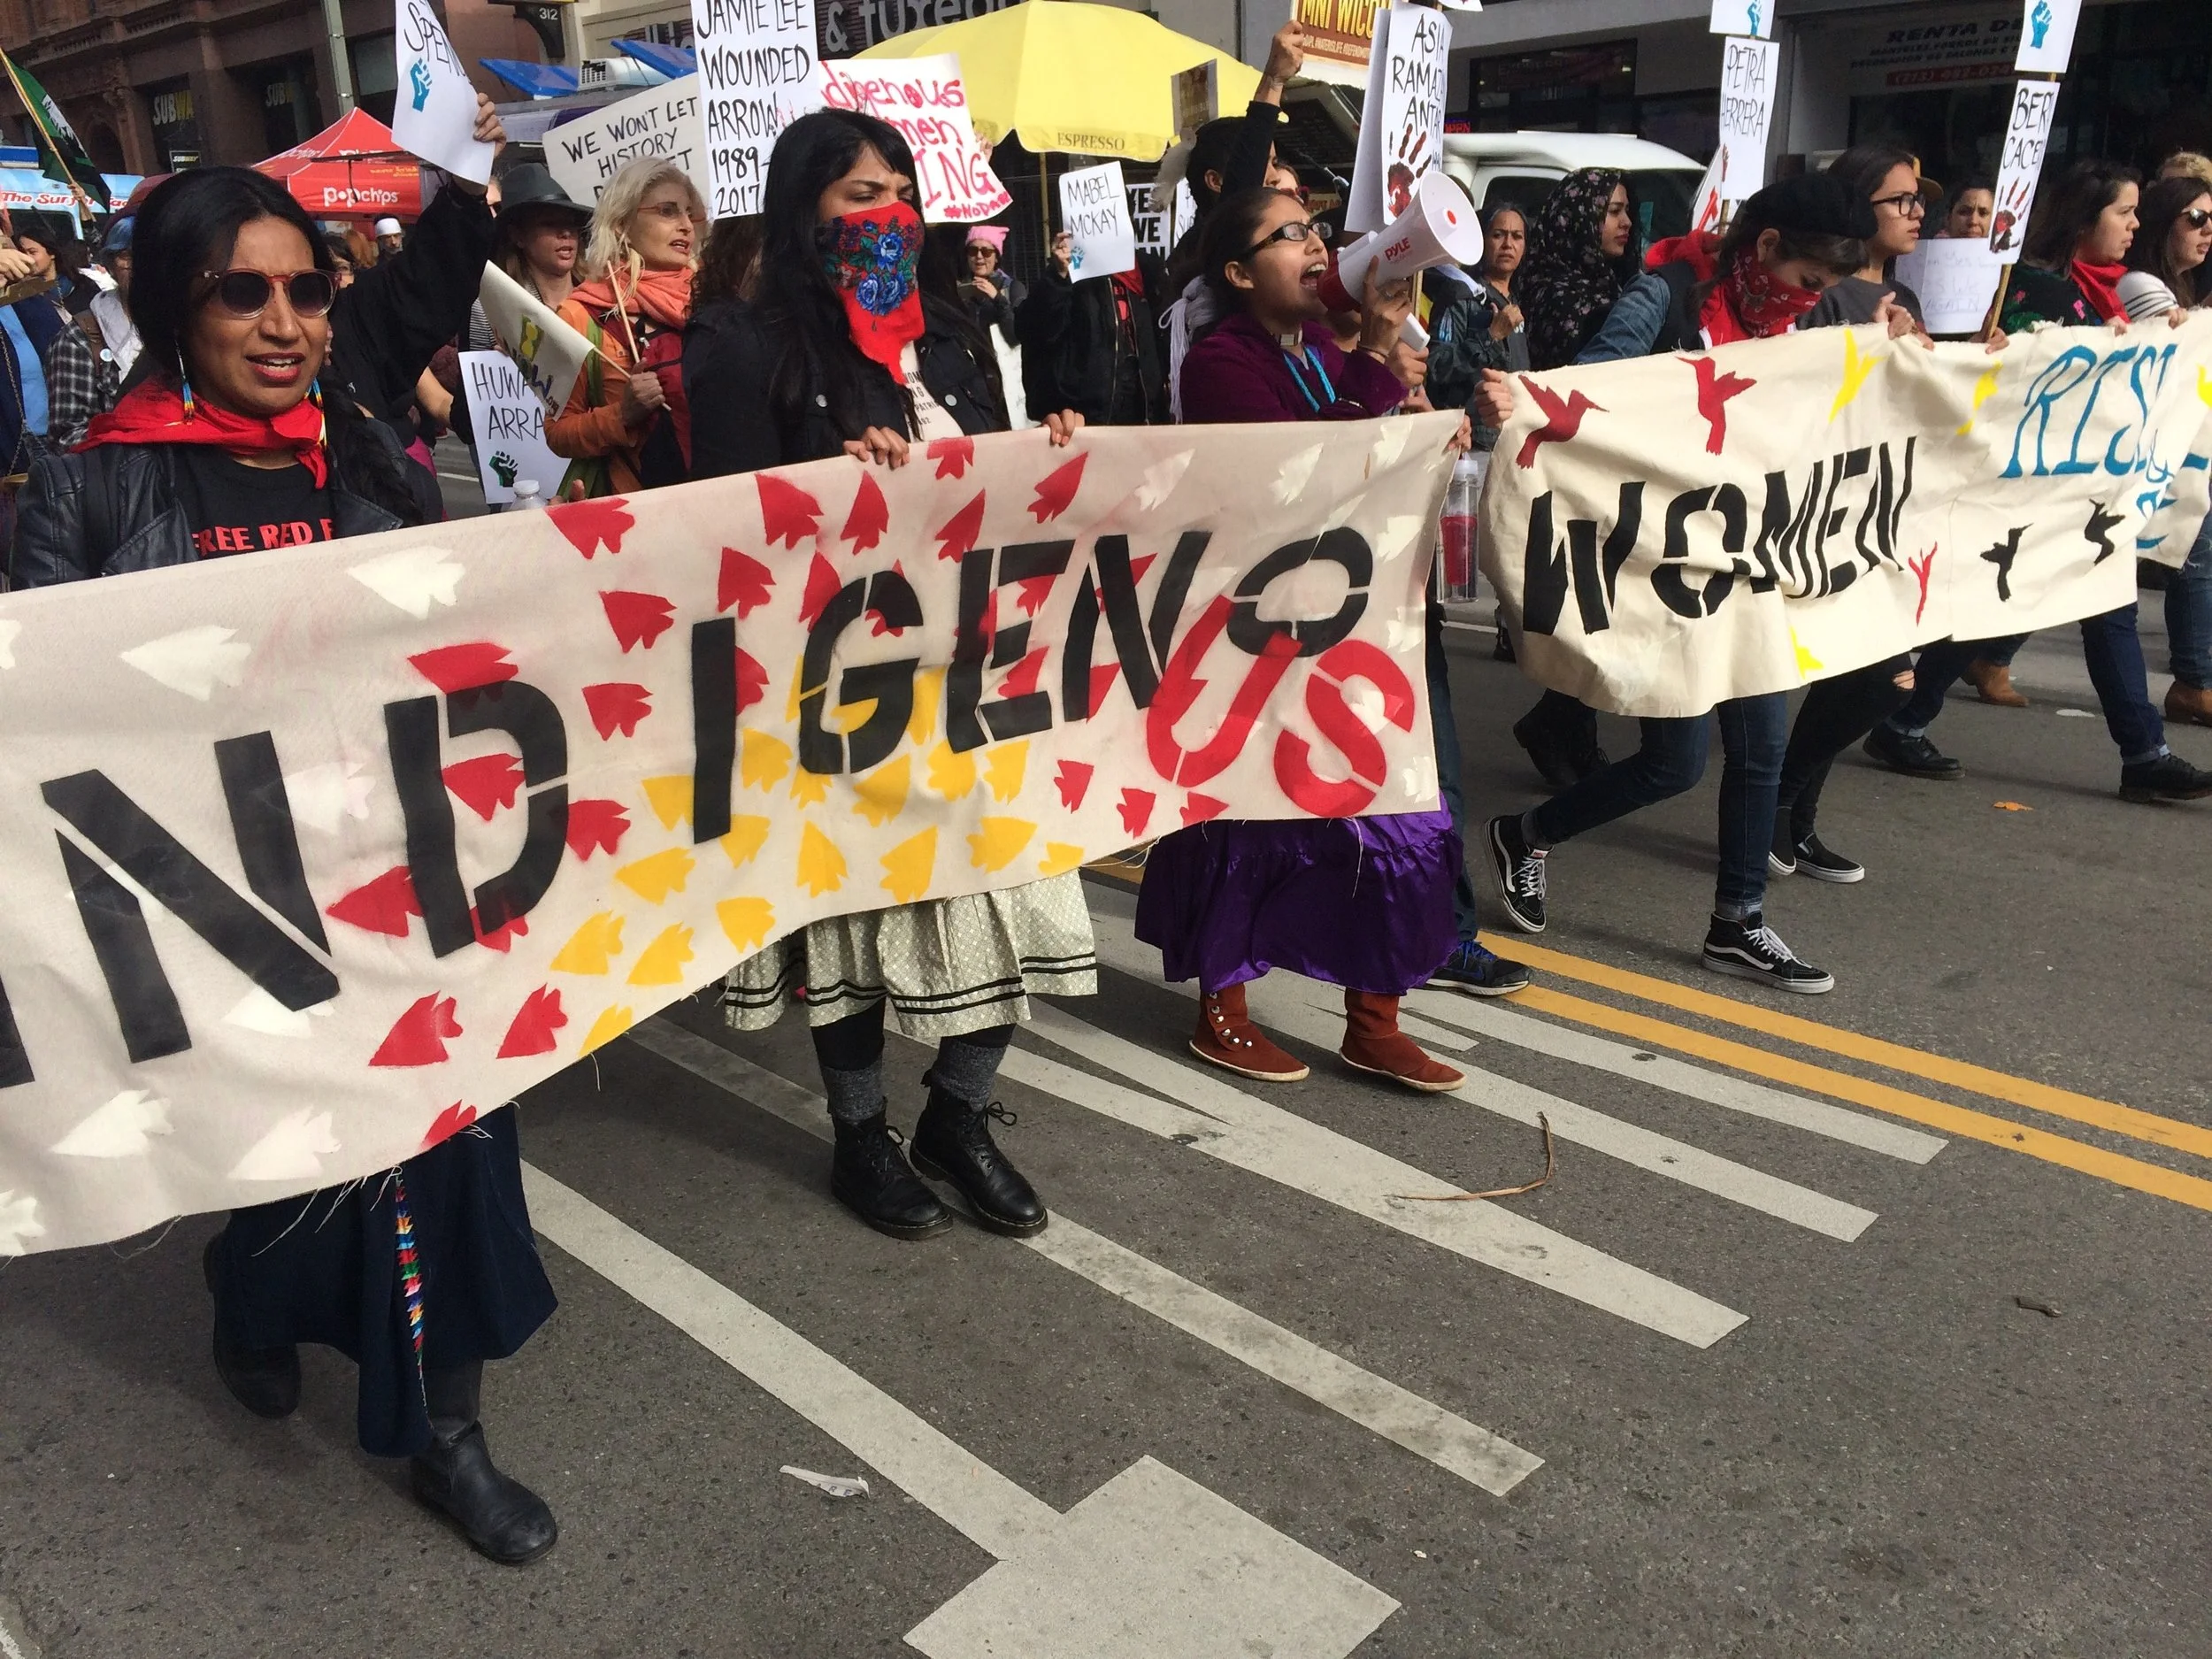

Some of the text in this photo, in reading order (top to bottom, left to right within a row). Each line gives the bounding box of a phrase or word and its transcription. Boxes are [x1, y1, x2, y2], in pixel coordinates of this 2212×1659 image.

[539, 7, 558, 21] 312
[697, 0, 769, 39] JAMIE
[775, 0, 810, 30] LEE
[857, 0, 1014, 48] tuxe
[1336, 0, 1387, 39] WICO
[1886, 22, 1978, 43] RENTA
[1411, 13, 1446, 63] ASIA
[701, 43, 810, 90] WOUNDED
[1726, 44, 1767, 94] PETRA
[153, 90, 195, 126] SUBWA
[708, 92, 780, 144] ARROW
[1721, 95, 1765, 144] HERRERA
[2013, 88, 2055, 134] BER
[562, 96, 697, 163] WE WON'T LET
[885, 117, 964, 148] men
[1057, 132, 1125, 151] ESPRESSO
[597, 127, 678, 178] HISTORY
[2003, 136, 2046, 170] CACE
[3, 192, 32, 203] The
[323, 186, 399, 208] popchips
[913, 148, 996, 209] ING
[1067, 172, 1121, 208] MABEL
[715, 183, 761, 216] 2017
[488, 405, 543, 442] ARRA
[258, 521, 313, 550] RED
[1522, 435, 1917, 637] WOMEN
